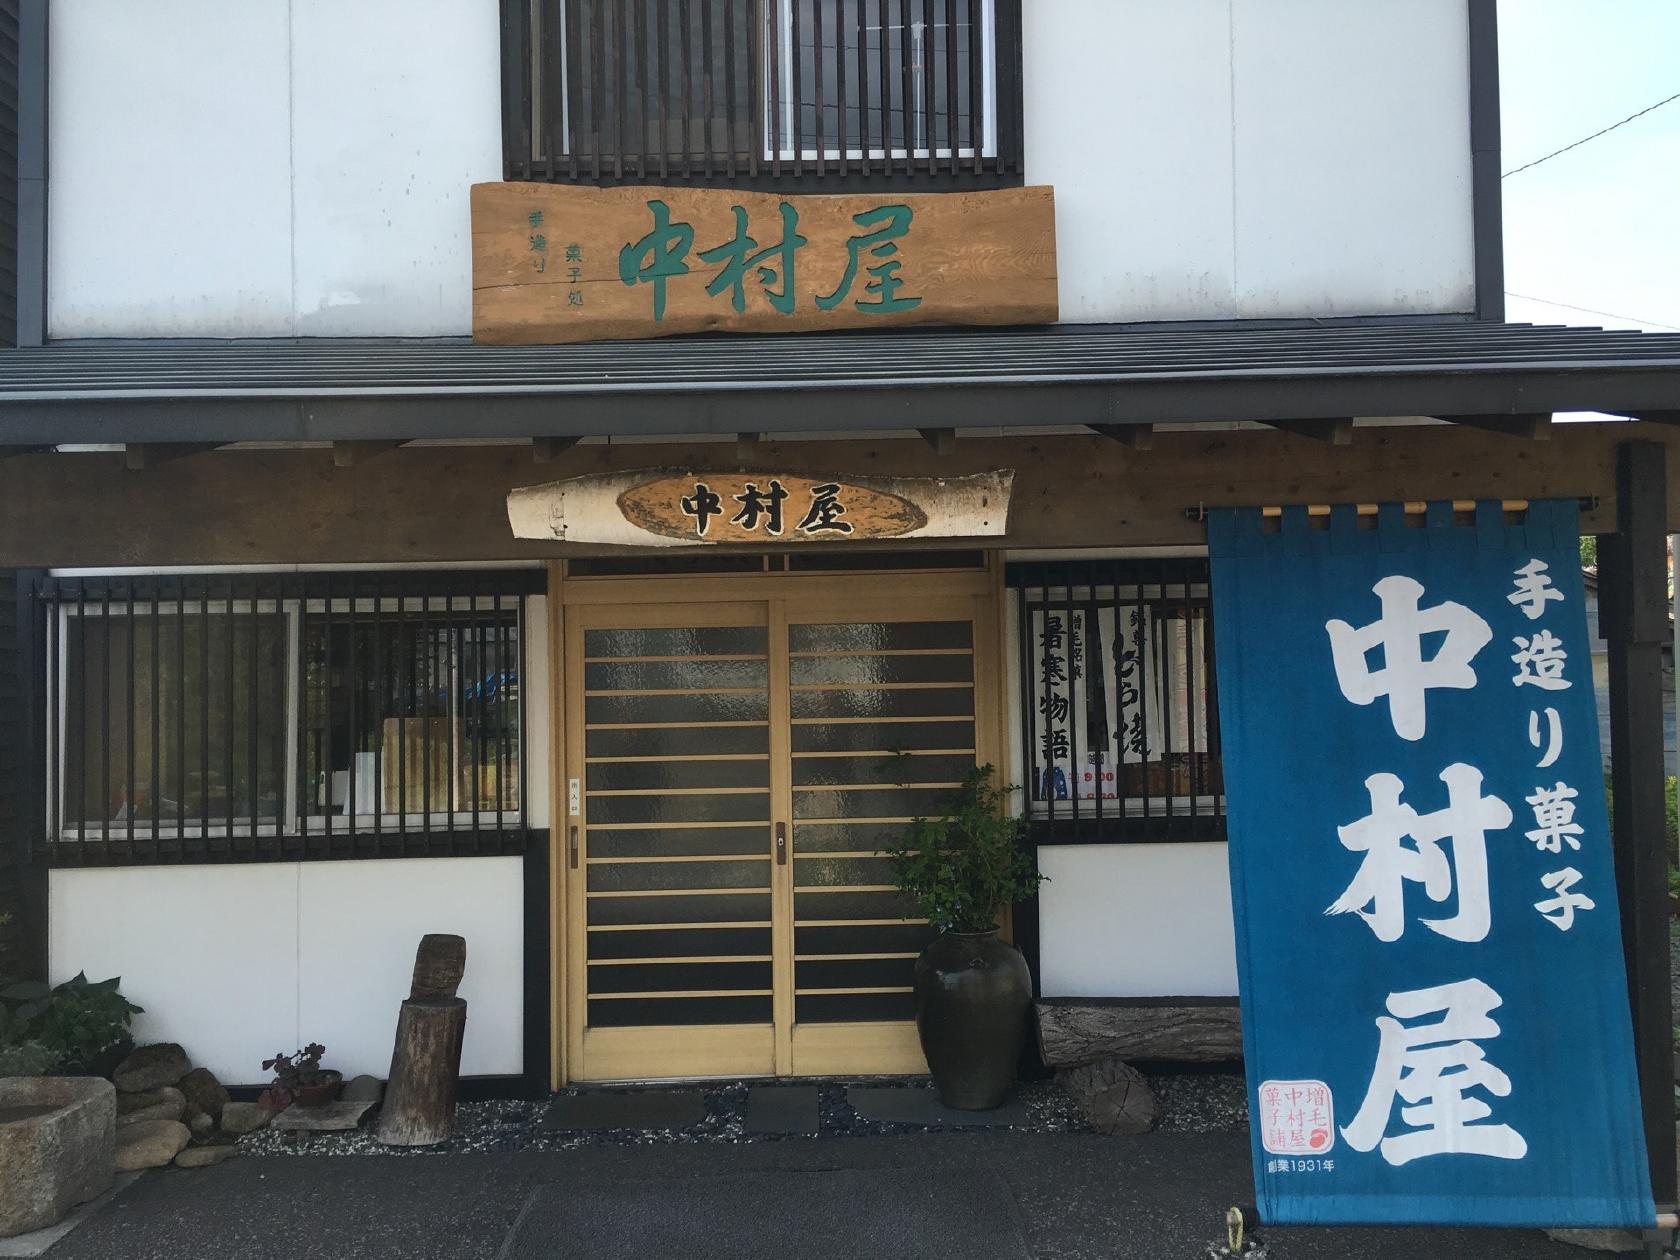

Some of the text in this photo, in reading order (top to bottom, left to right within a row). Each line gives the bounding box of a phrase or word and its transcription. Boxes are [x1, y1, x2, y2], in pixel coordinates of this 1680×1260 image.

[528, 210, 548, 274] 手造り
[619, 200, 922, 322] 中村屋
[565, 242, 585, 308] 菓子処
[680, 479, 855, 537] 中村屋
[1506, 558, 1595, 932] 手造り菓子
[1324, 574, 1528, 1166] 中村屋
[1284, 1087, 1306, 1147] 中村屋
[1306, 1087, 1327, 1127] 増毛
[1267, 1160, 1335, 1173] 創業1931年
